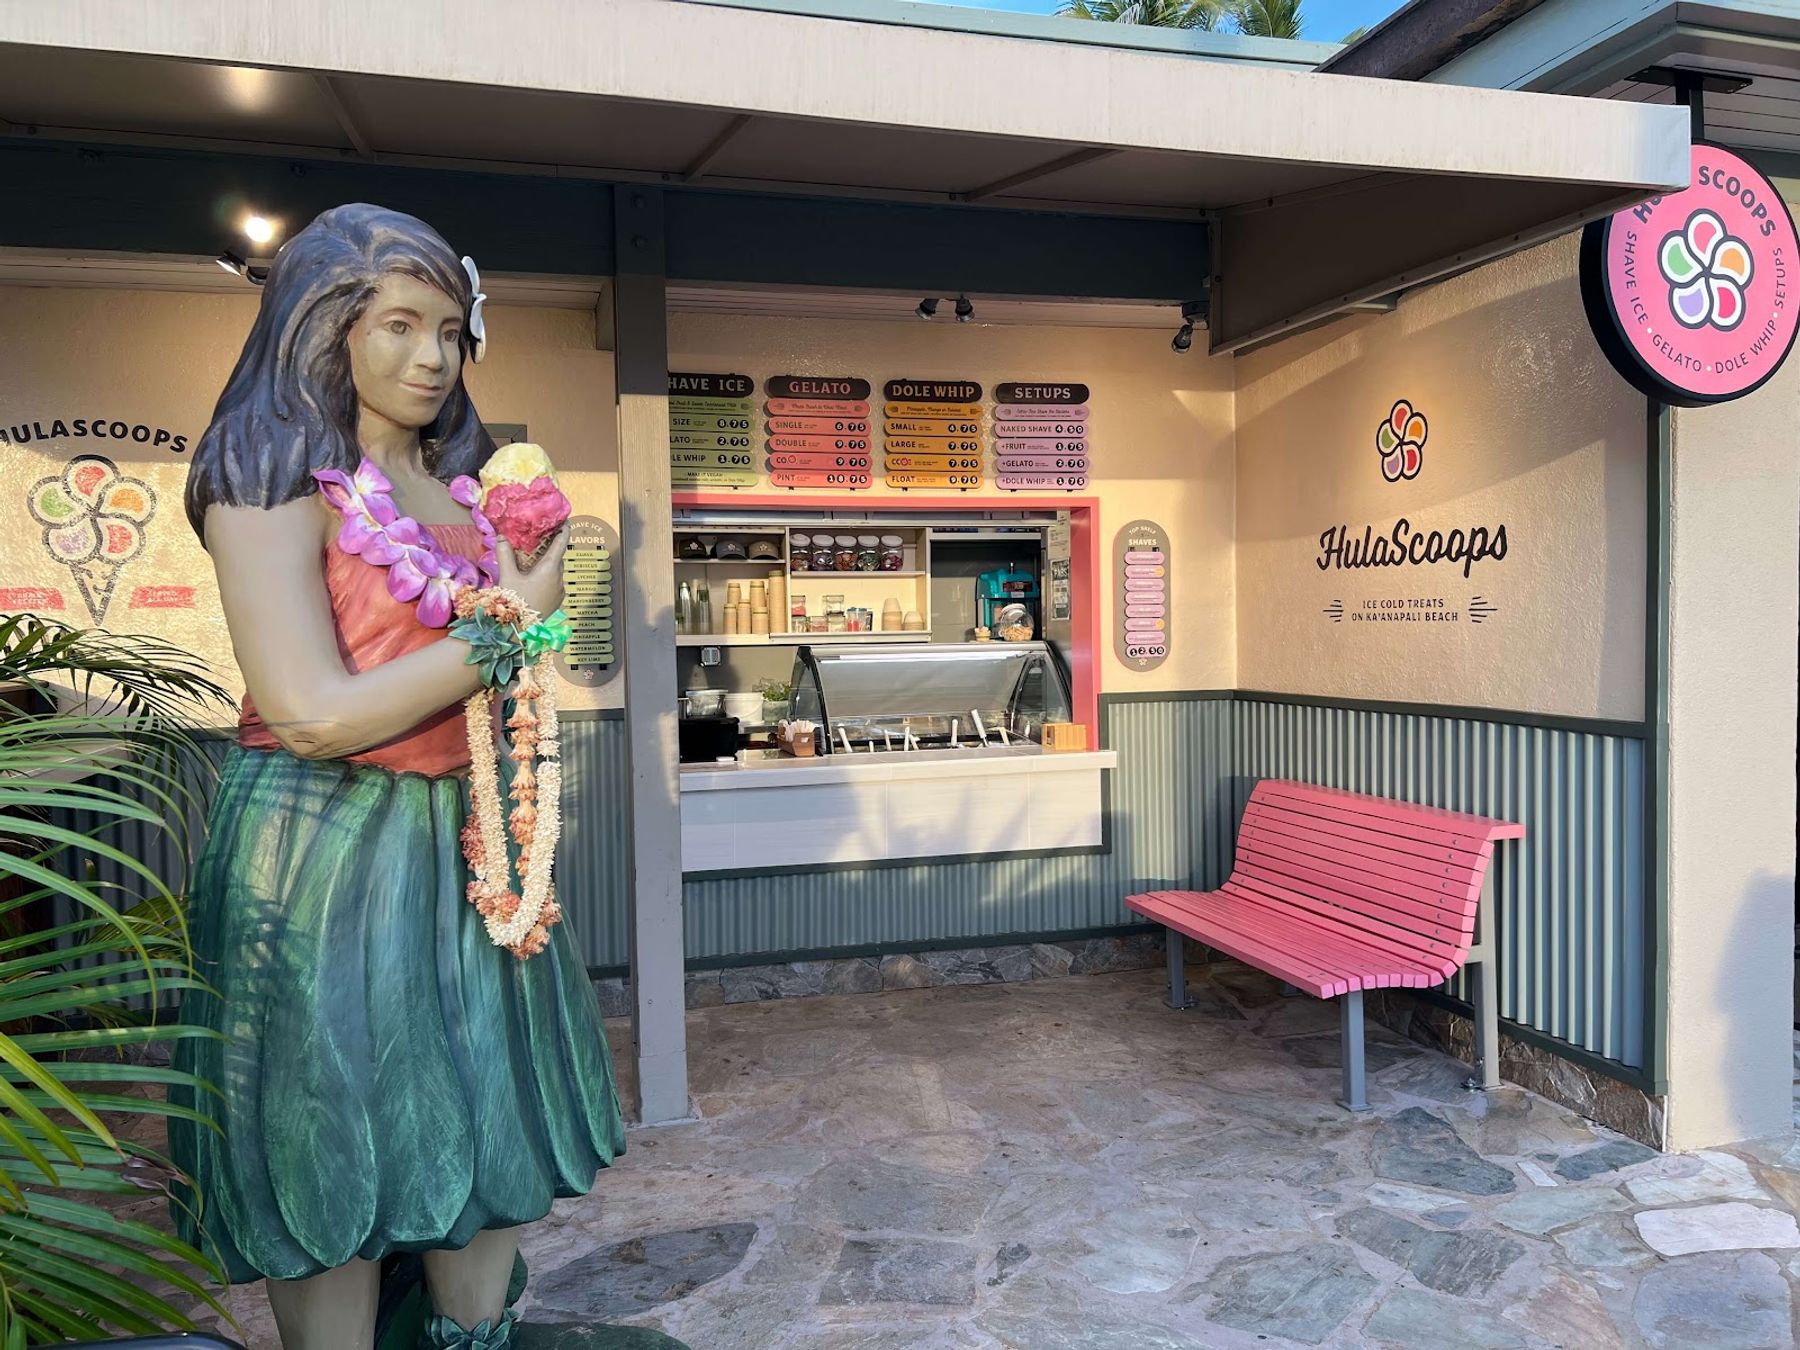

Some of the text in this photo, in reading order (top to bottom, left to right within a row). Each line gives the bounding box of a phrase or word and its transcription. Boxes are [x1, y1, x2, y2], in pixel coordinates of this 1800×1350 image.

[1624, 231, 1786, 374] SHAVE ICE GELATO DOLE WHIP SETUPS
[668, 377, 745, 391] HAVE ICE
[789, 381, 850, 394] GELATO
[892, 385, 975, 398] DOLE WHIP
[1015, 387, 1071, 399] SETUPS
[836, 422, 866, 431] 6.75
[949, 424, 977, 433] 4.75
[718, 437, 749, 446] 2.75
[836, 440, 866, 449] 9.75
[949, 442, 977, 450] 7.75
[1056, 443, 1084, 451] 1.75
[718, 455, 750, 464] 1.75
[837, 457, 867, 466] 9.75
[949, 459, 978, 468] 7.75
[1057, 459, 1085, 468] 2.75
[1057, 477, 1085, 485] 1.75
[570, 536, 605, 544] LAVORS
[1316, 518, 1507, 578] HulaScoops
[1363, 599, 1444, 609] ICE COLD TREATS
[1352, 613, 1363, 621] ON
[1425, 612, 1458, 621] BEACH
